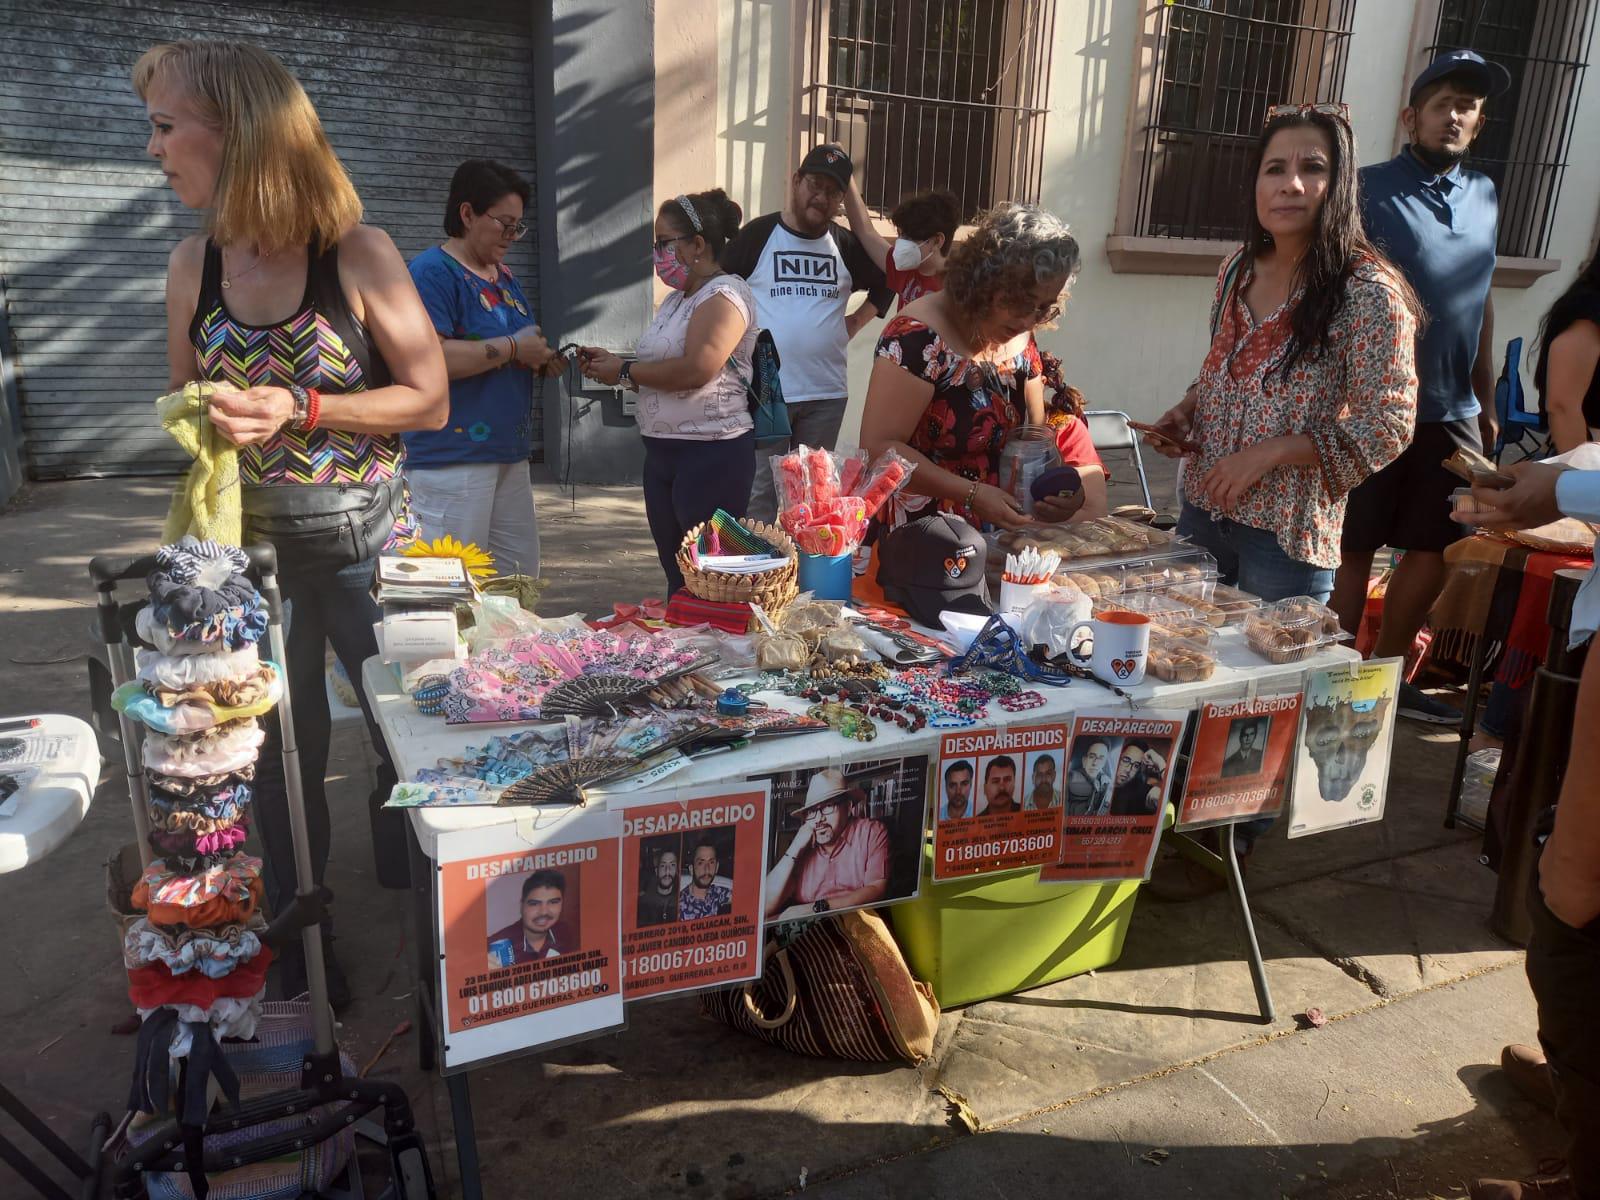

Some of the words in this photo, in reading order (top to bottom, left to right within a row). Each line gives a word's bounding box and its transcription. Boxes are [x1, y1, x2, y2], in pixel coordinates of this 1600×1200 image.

[781, 258, 831, 277] NIN
[770, 285, 792, 298] nine
[795, 284, 817, 297] inch
[821, 286, 840, 299] nails
[1081, 719, 1173, 735] DESAPARECIDO
[945, 729, 1064, 754] DESAPARECIDOS
[623, 803, 756, 837] DESAPARECIDO
[945, 834, 1054, 862] 018006703600
[466, 846, 598, 880] DESAPARECIDO
[628, 927, 666, 941] FEBRERO
[636, 940, 662, 953] JAVIER
[663, 935, 695, 949] CANDIDO
[696, 932, 719, 944] OJEDA
[459, 988, 478, 999] LUIS
[479, 979, 513, 995] ENRIQUE
[514, 970, 551, 986] ADELAIDO
[552, 963, 581, 979] BERNAL
[582, 957, 609, 971] VALDEZ
[489, 968, 511, 981] JULIO
[532, 962, 541, 971] EL
[542, 954, 587, 969] TAMARINDO
[468, 993, 489, 1015] 01
[491, 985, 526, 1009] 800
[529, 968, 602, 1001] 6703600
[472, 1005, 520, 1023] SABUESOS
